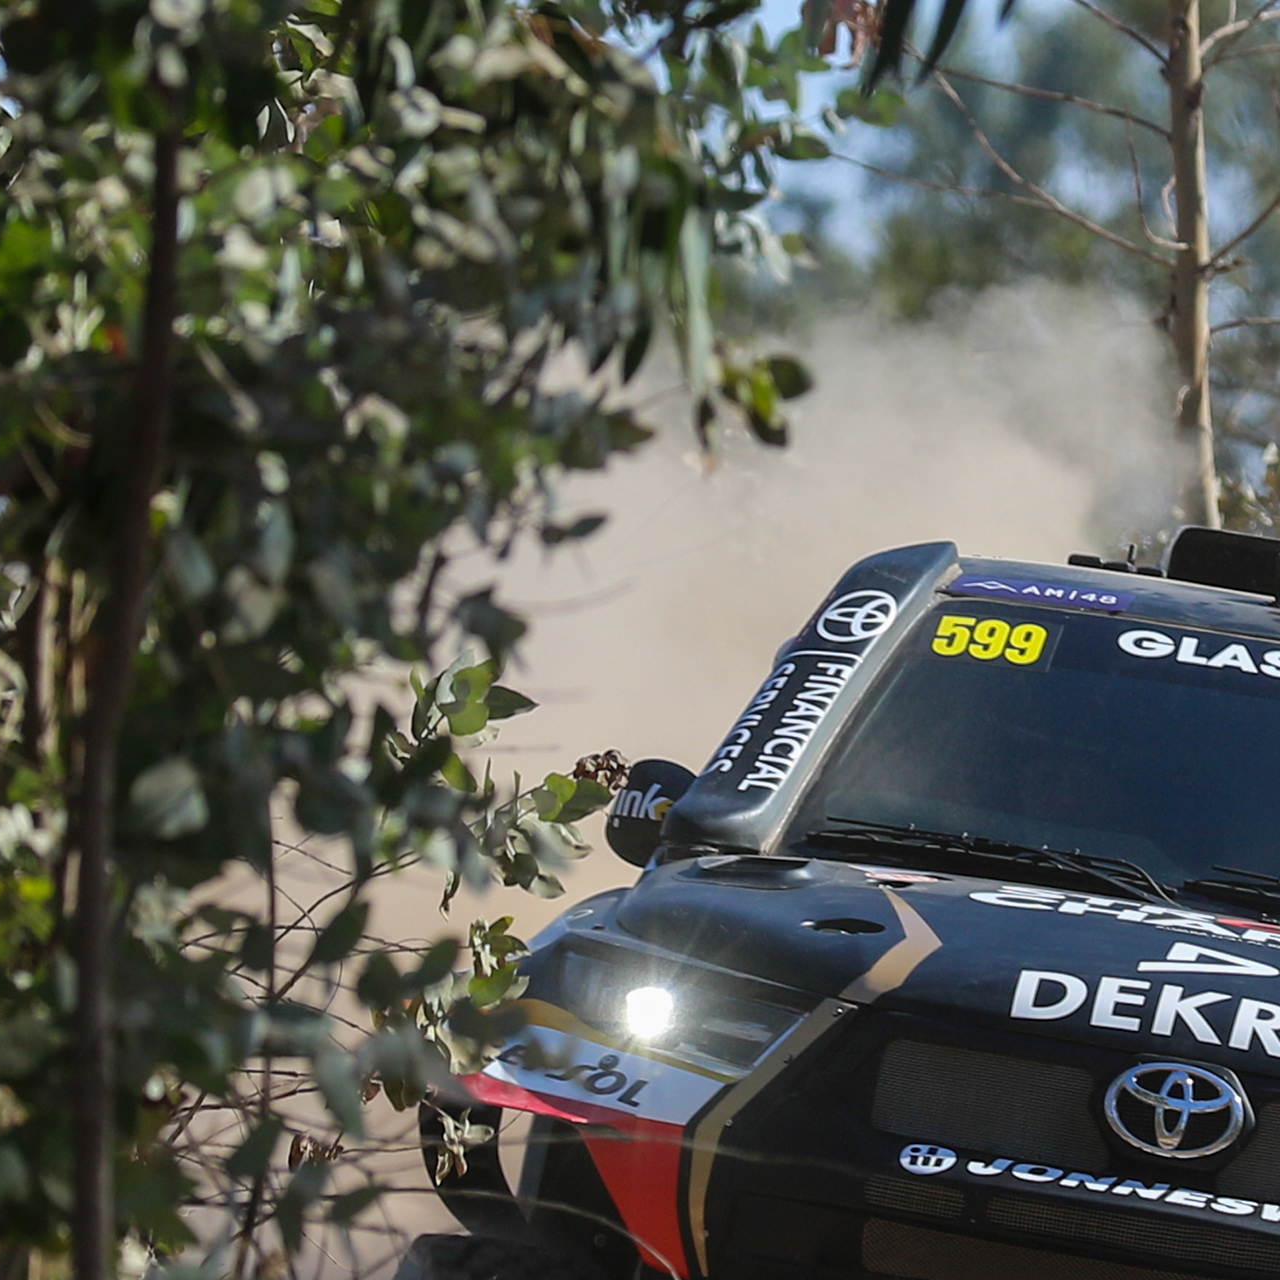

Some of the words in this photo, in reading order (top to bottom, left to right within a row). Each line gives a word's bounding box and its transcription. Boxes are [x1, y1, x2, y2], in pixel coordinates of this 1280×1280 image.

[931, 615, 1048, 665] 599
[703, 662, 796, 775] SERVICES
[738, 661, 856, 791] FINANCIAL
